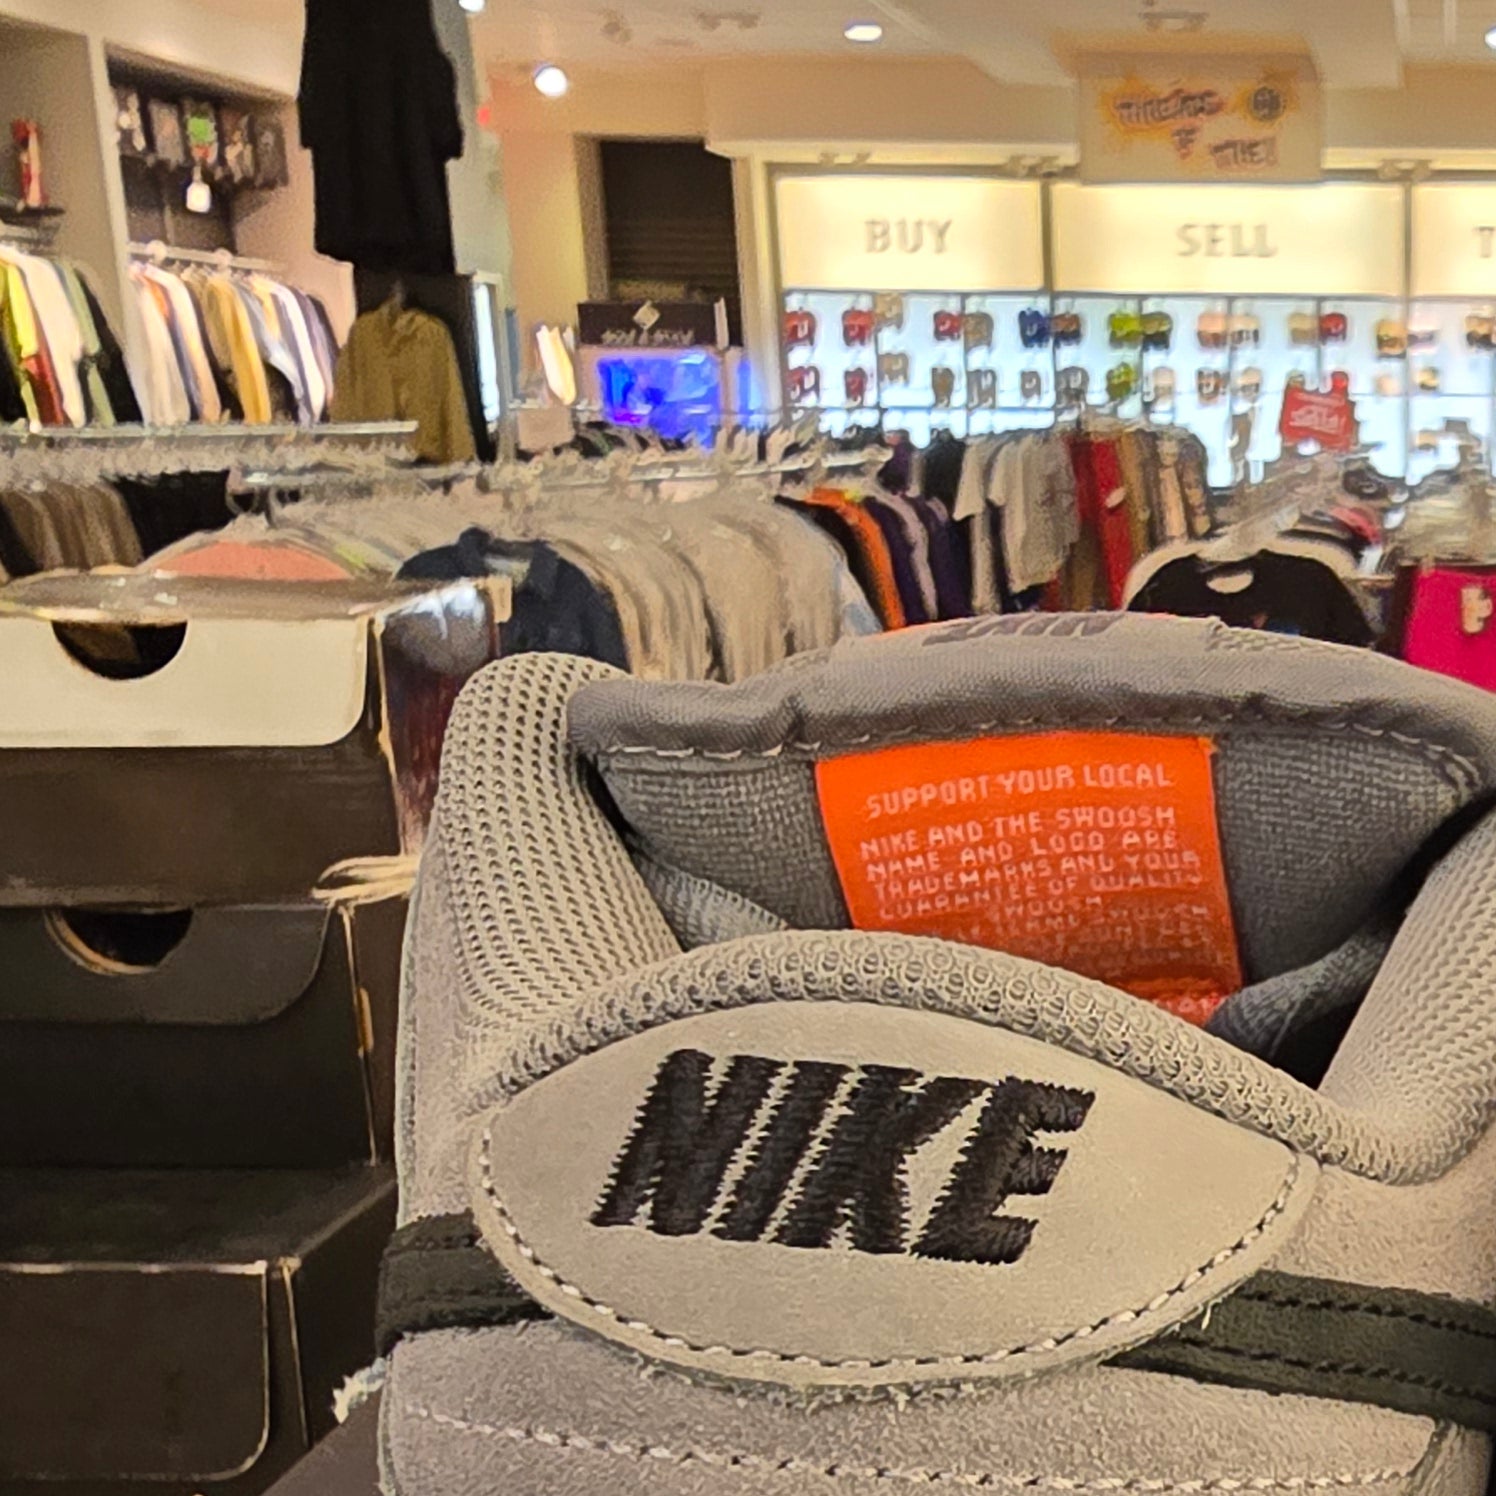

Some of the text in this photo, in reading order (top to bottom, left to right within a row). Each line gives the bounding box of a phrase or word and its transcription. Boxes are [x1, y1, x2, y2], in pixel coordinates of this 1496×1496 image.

[864, 218, 952, 254] BUY
[1176, 223, 1278, 258] SELL
[866, 763, 1174, 821] SUPPORT YOUR LOCAL
[860, 804, 1176, 861] NIKE AND THE SWOOSH
[867, 829, 1177, 882] NAME AND LOGO ARE
[874, 850, 1201, 900] TRADEMARKS AND YOUR
[587, 1048, 1096, 1266] NIKE
